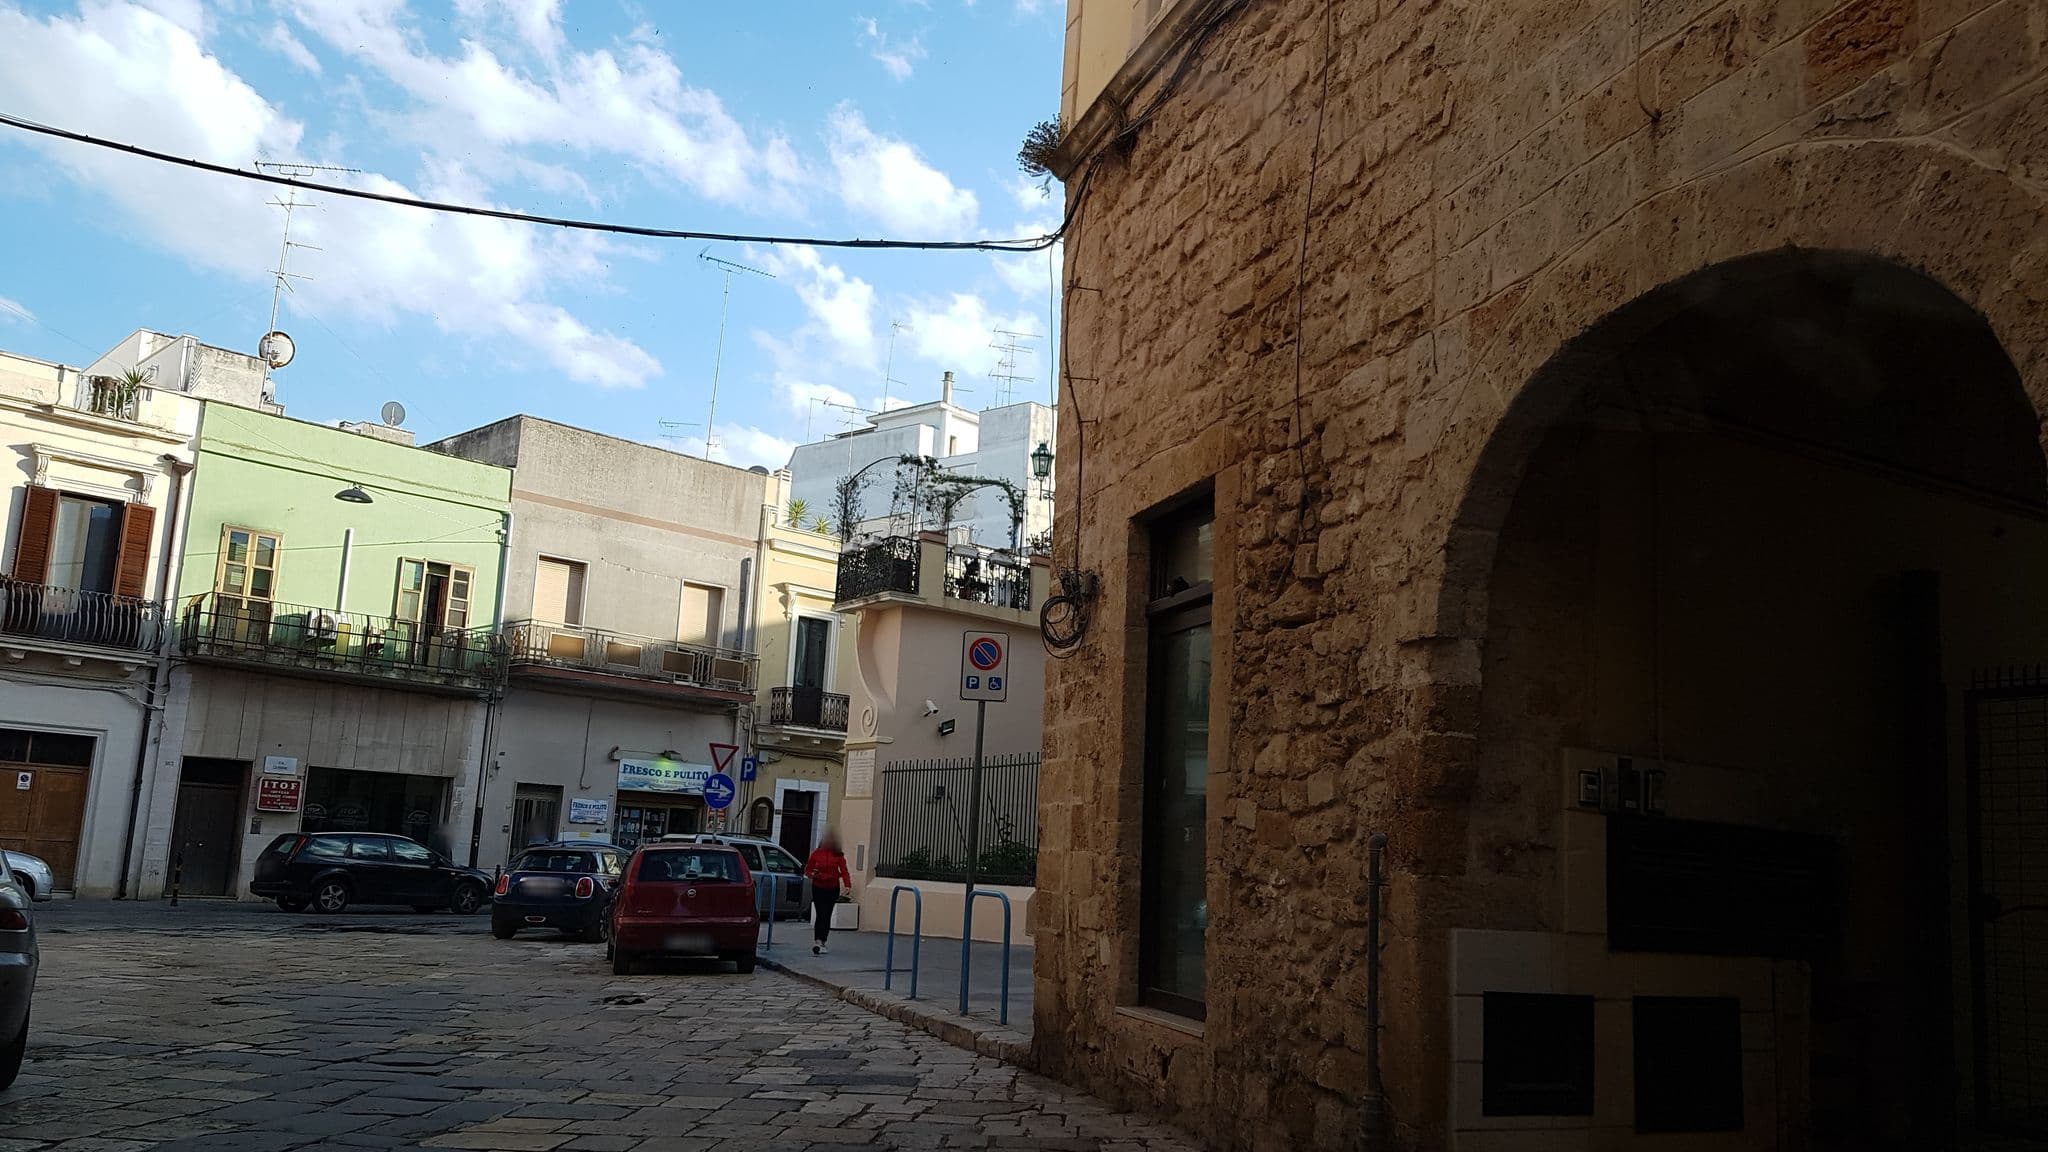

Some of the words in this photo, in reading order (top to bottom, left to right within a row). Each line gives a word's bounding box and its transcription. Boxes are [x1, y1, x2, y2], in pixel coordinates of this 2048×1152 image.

[969, 678, 977, 688] P
[623, 764, 662, 777] FRESCO
[664, 770, 671, 778] E
[673, 770, 709, 781] PULITO
[744, 760, 753, 778] P
[263, 781, 298, 790] ITOF
